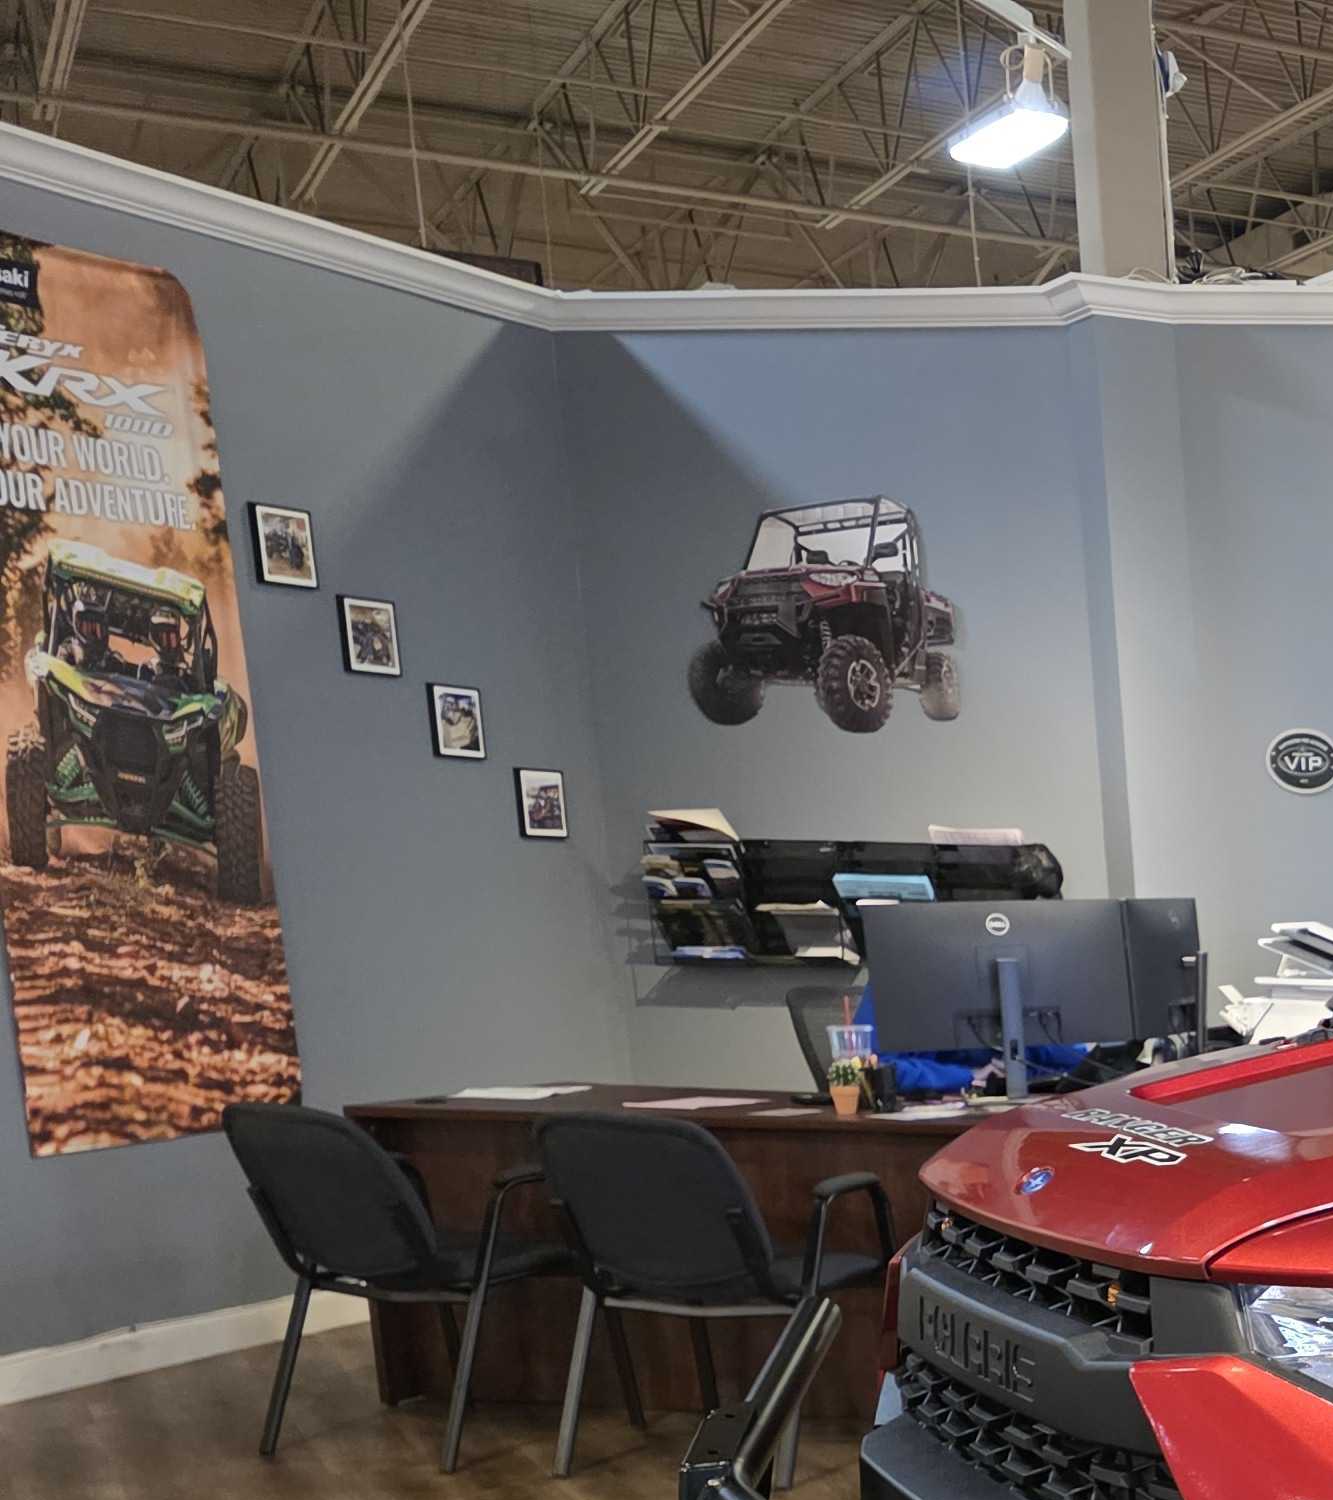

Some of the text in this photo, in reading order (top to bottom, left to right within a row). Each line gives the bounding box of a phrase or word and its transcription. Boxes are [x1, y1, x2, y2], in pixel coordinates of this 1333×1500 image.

[104, 414, 174, 441] 1000
[72, 433, 170, 485] WORLD.
[54, 477, 197, 531] ADVENTURE.
[1283, 755, 1323, 772] VIP
[1061, 1108, 1214, 1147] RANGER
[1068, 1133, 1188, 1166] XP
